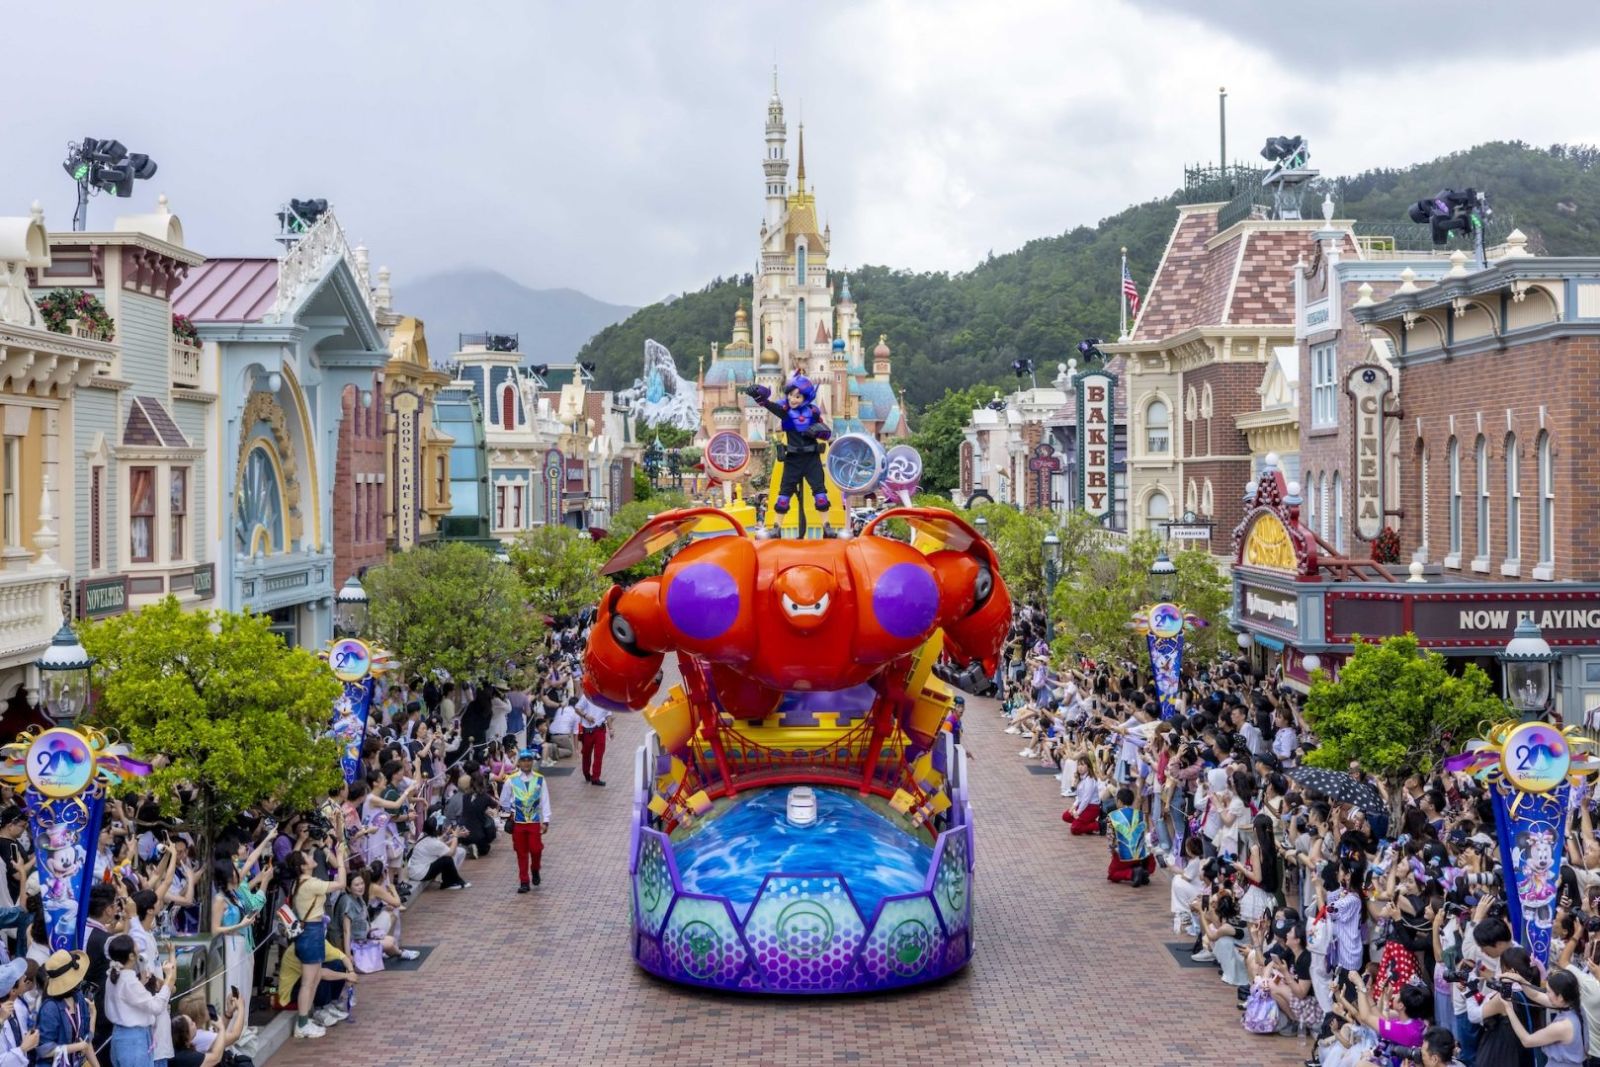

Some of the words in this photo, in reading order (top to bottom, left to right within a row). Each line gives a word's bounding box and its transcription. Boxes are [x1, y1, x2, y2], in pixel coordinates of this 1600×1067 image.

[402, 413, 410, 450] GOODS
[1086, 386, 1107, 509] BAKERY
[1359, 396, 1379, 519] CINEMA
[402, 468, 410, 498] FINE
[402, 504, 410, 542] GIFTS
[86, 585, 124, 611] NOVELTIES
[1460, 610, 1509, 630] NOW
